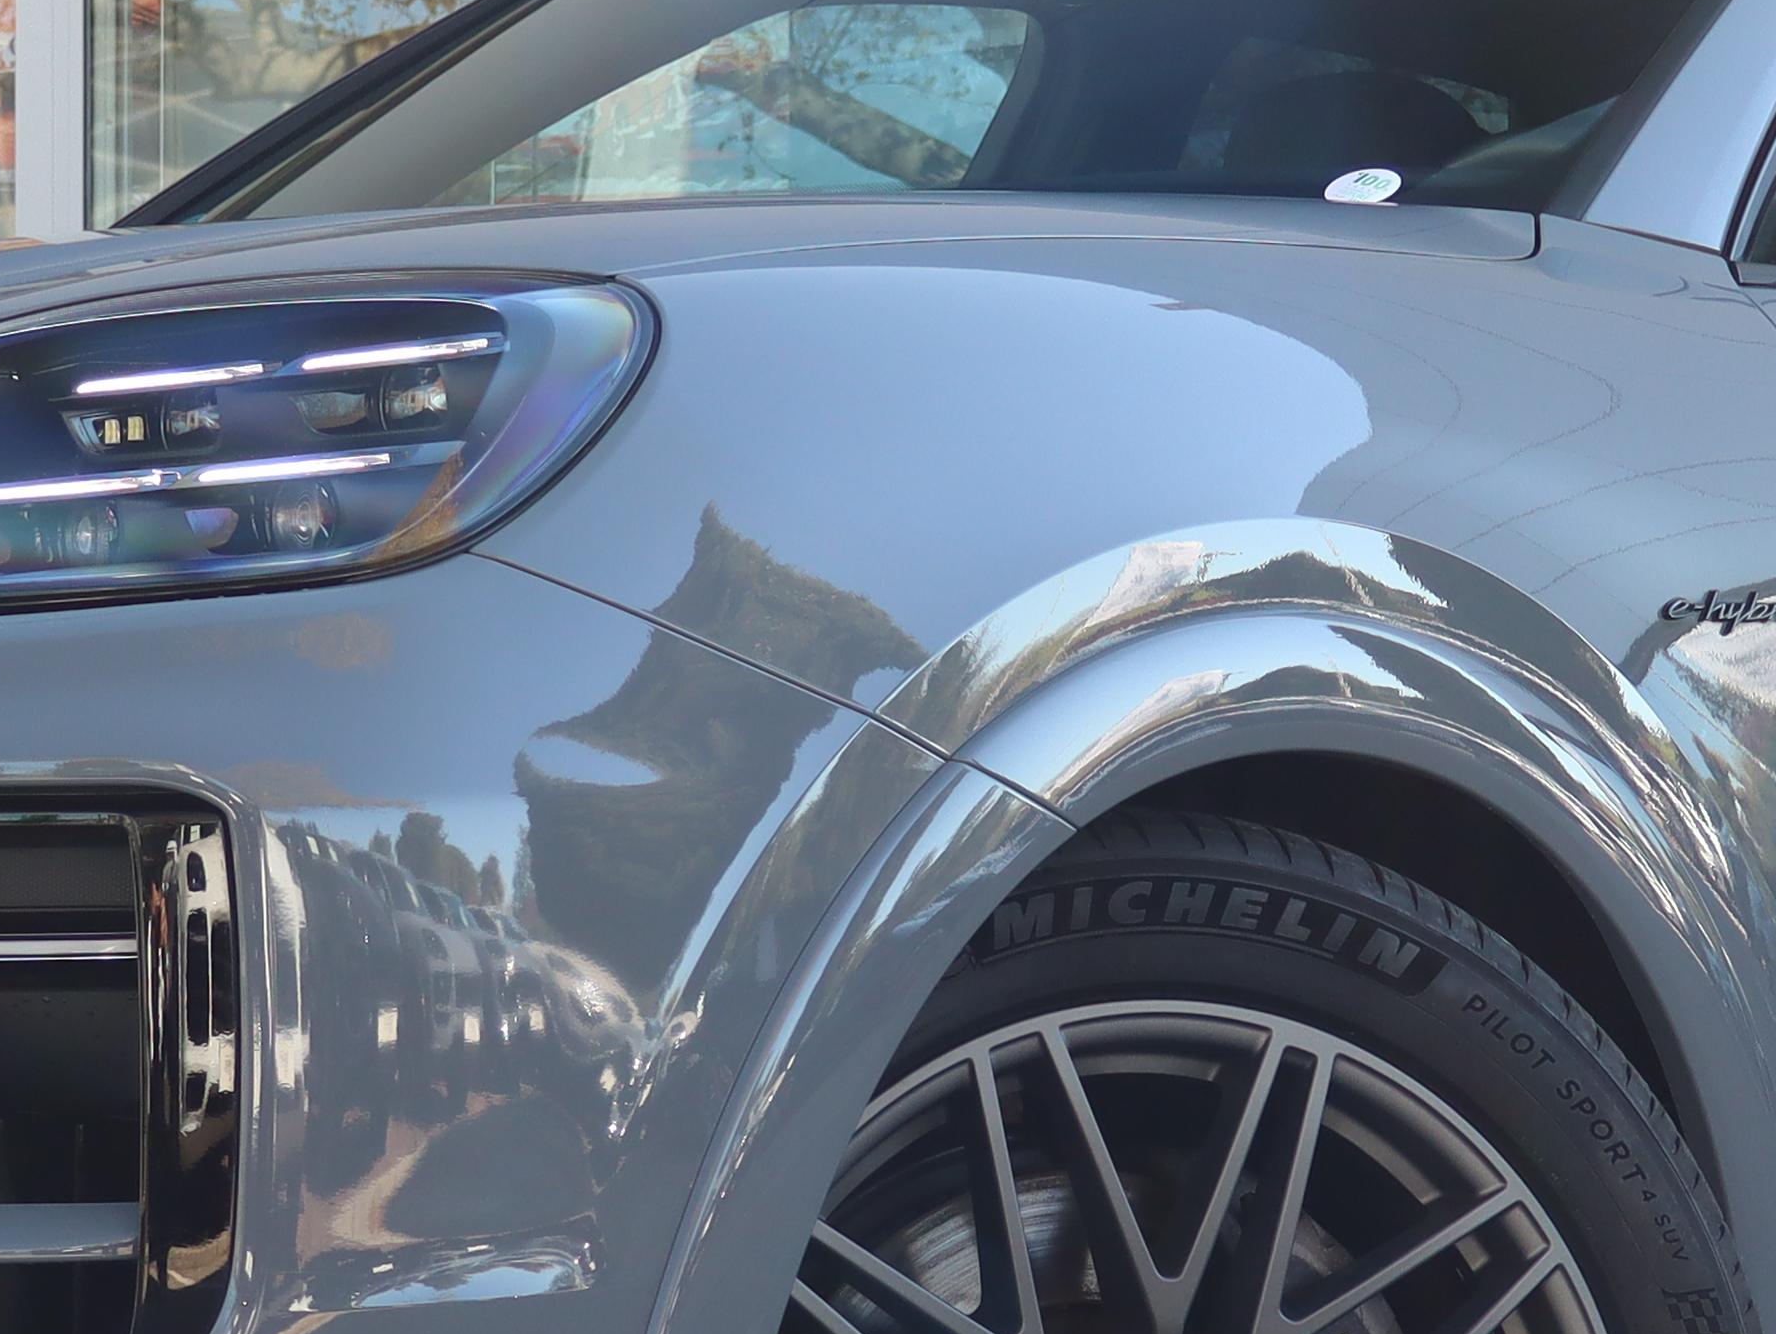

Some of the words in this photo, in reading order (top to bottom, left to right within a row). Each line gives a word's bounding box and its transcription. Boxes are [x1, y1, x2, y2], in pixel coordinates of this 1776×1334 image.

[993, 880, 1421, 980] MICHELIN
[1461, 993, 1556, 1070] PILOT
[1556, 1079, 1646, 1182] SPORT
[1641, 1189, 1658, 1204] 4
[1654, 1213, 1689, 1263] SUV
